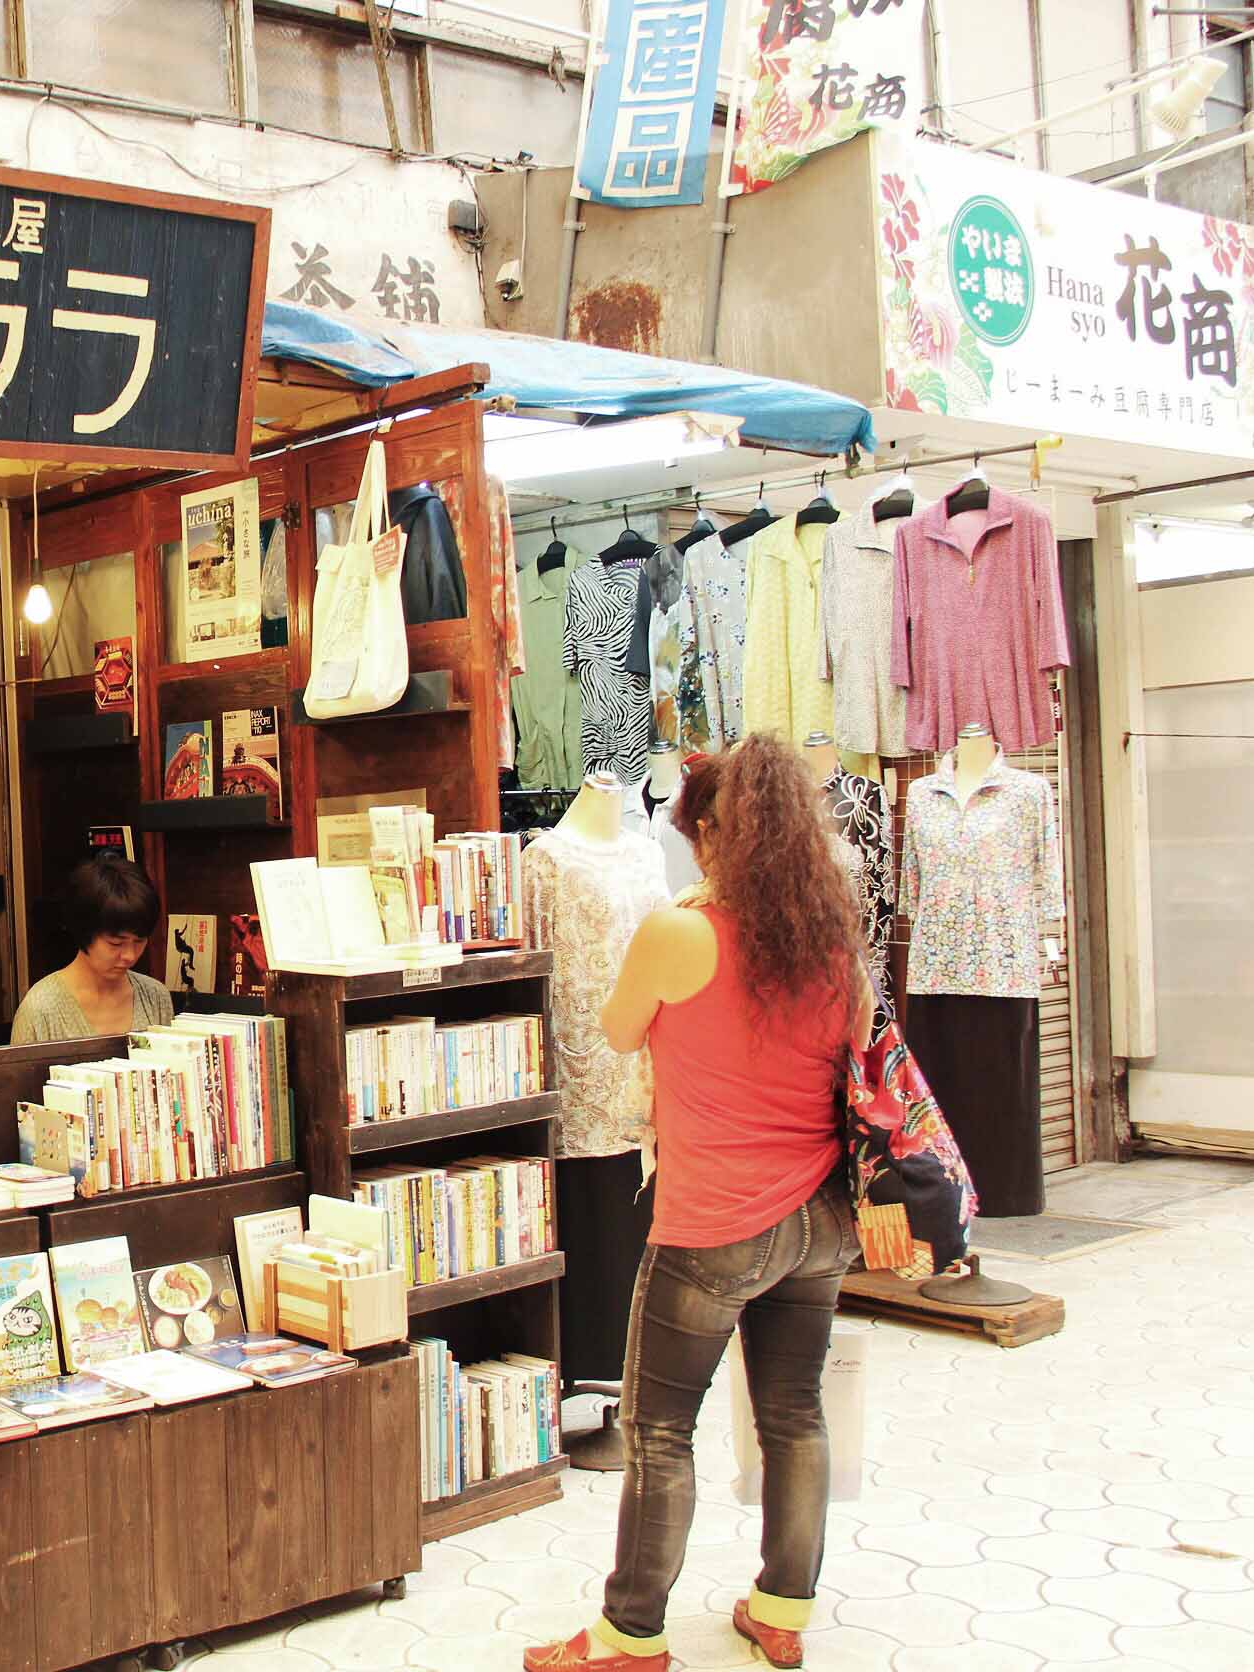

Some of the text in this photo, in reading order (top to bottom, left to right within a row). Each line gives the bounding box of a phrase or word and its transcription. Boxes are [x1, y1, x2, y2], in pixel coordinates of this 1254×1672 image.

[809, 62, 906, 121] 花商
[1046, 266, 1105, 306] Hana
[1113, 233, 1237, 387] 花商
[1071, 309, 1106, 343] syo
